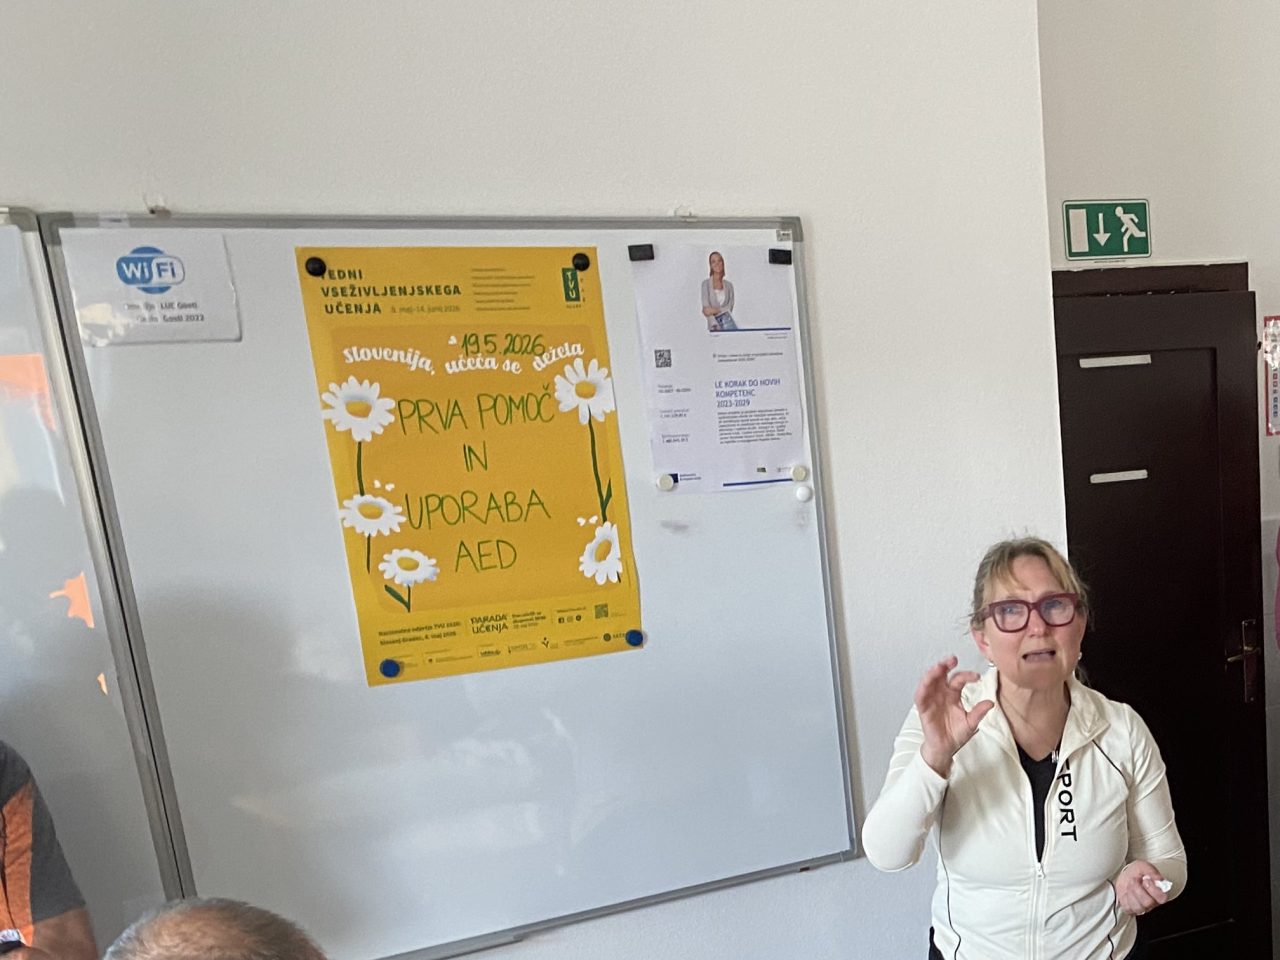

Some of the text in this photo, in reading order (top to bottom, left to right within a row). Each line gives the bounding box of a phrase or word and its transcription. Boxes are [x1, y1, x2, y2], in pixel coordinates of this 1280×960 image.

[121, 261, 177, 280] WiFi
[321, 284, 462, 298] VSEŽIVLJENJSKEGA
[324, 302, 382, 314] UČENJA
[502, 359, 522, 375] se
[532, 342, 584, 371] dežela
[397, 383, 555, 436] PRVA POMOČ
[463, 440, 488, 473] IN
[405, 488, 552, 531] UPORABA
[455, 540, 518, 573] AED
[471, 613, 508, 624] PARADA
